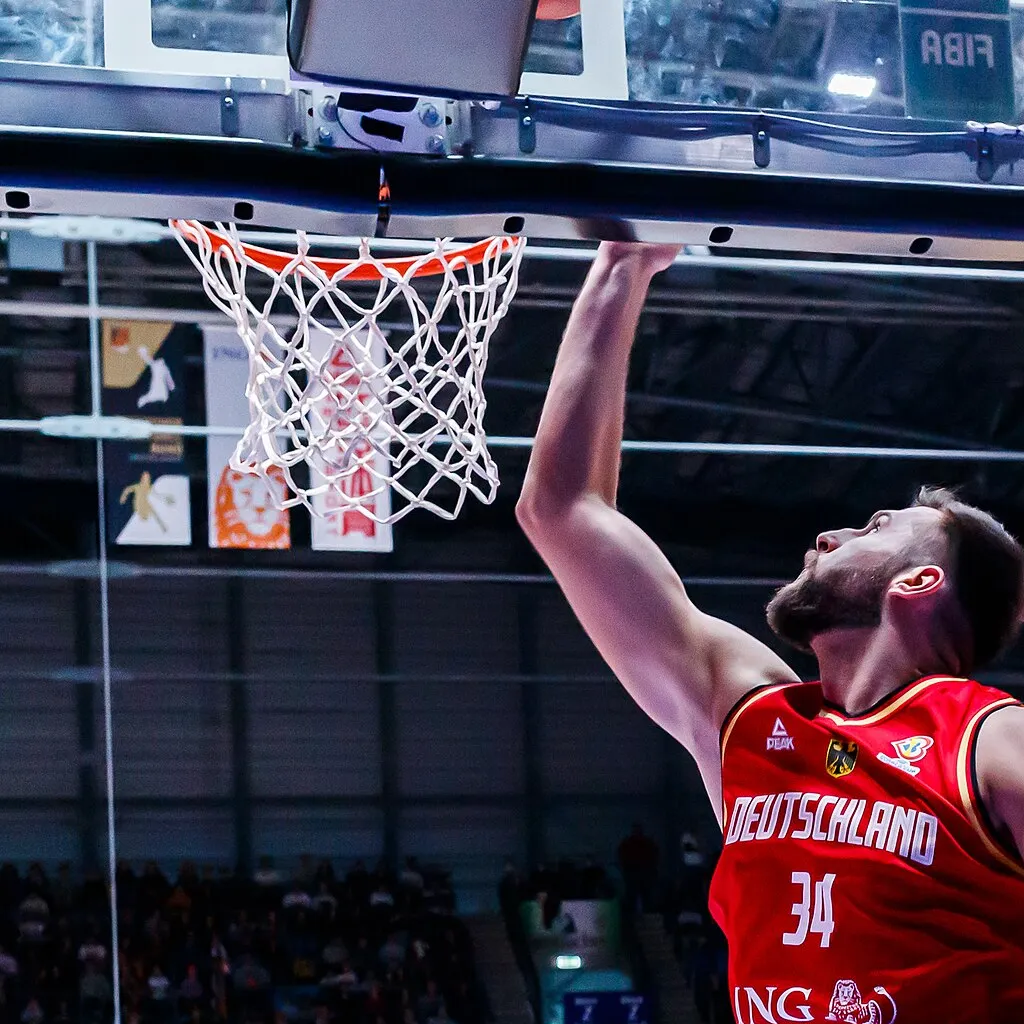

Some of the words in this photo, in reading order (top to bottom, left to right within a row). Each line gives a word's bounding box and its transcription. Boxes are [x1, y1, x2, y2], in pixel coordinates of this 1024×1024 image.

[766, 736, 795, 750] PEAK
[725, 791, 938, 866] DEUTSCHLAND
[782, 871, 837, 948] 34
